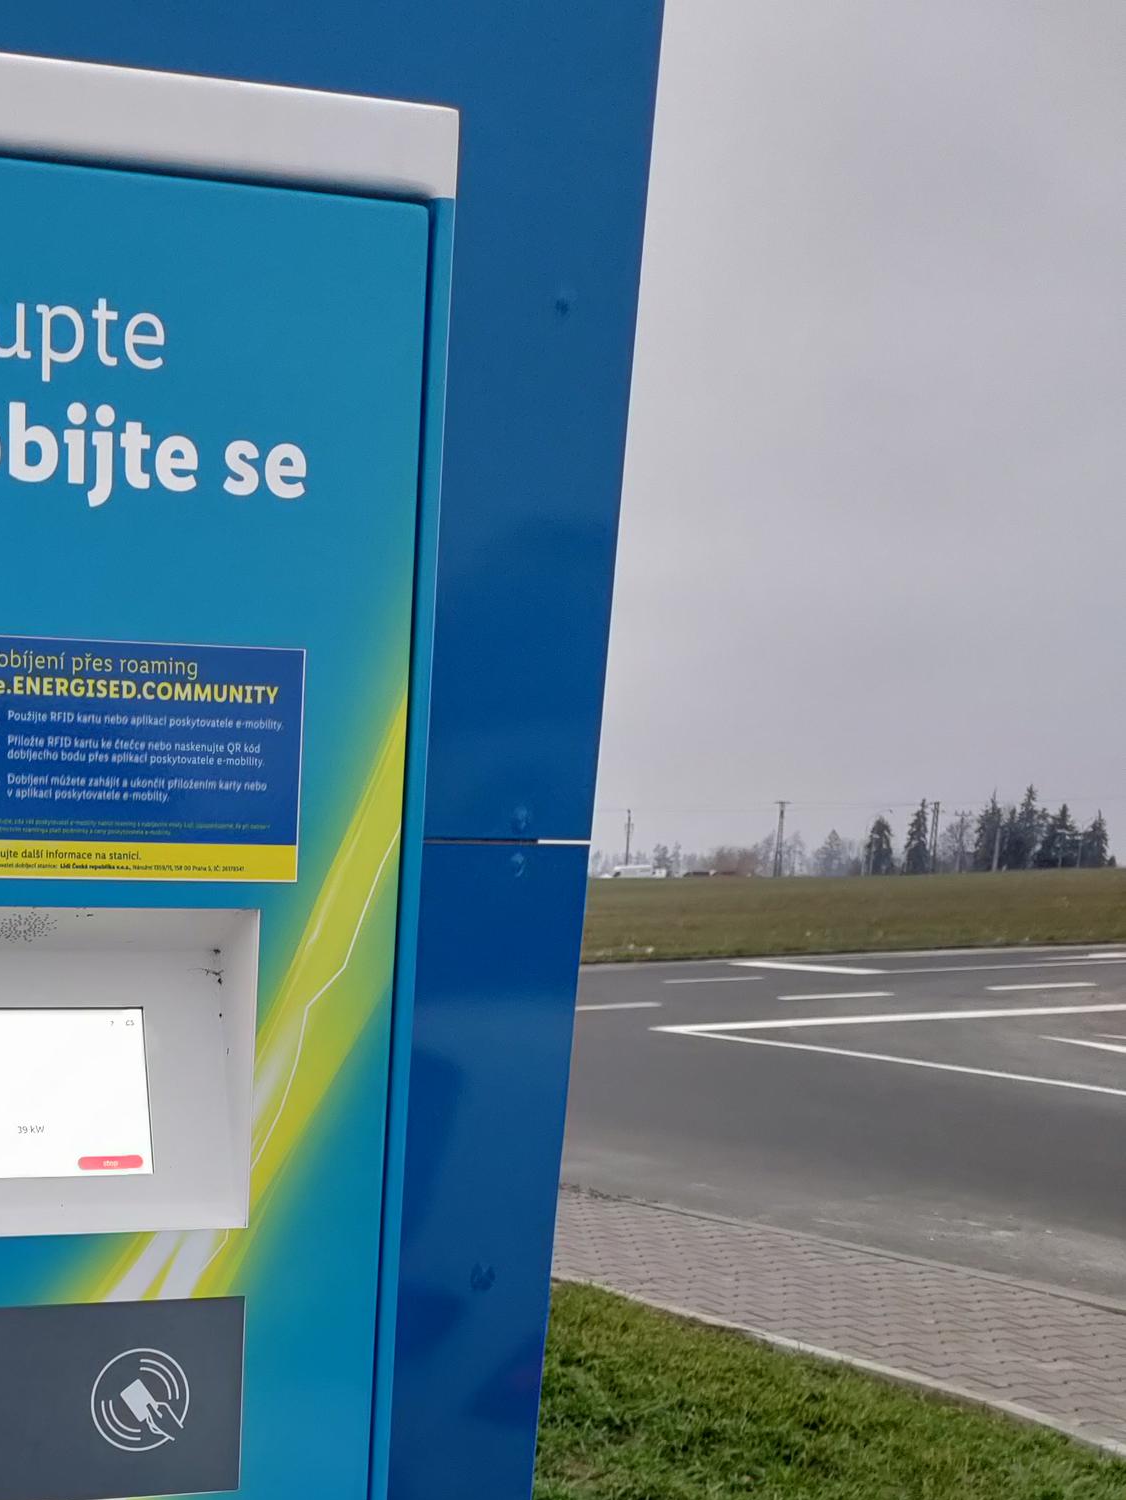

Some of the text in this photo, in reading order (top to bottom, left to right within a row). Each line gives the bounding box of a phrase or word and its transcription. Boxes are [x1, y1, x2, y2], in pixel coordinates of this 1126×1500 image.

[223, 438, 308, 500] se
[71, 651, 113, 675] přes
[120, 658, 199, 681] roaming
[7, 710, 47, 723] Použijte
[50, 711, 75, 722] RFID
[77, 713, 102, 724] kartu
[104, 714, 128, 725] nebo
[130, 715, 167, 727] aplikaci
[169, 716, 233, 729] poskytovatele
[7, 734, 44, 747] Přiložte
[47, 736, 71, 748] RFID
[74, 737, 99, 749] kartu
[101, 739, 112, 749] ke
[148, 740, 172, 751] nebo
[174, 742, 225, 754] naskenujte
[227, 743, 242, 755] QR
[244, 743, 260, 754] kód
[61, 750, 86, 761] bodu
[88, 751, 109, 763] přes
[111, 751, 148, 765] aplikaci
[150, 753, 214, 766] poskytovatele
[51, 775, 86, 786] můžete
[88, 775, 120, 789] zahájit
[122, 778, 128, 787] a
[131, 777, 165, 789] ukončit
[167, 778, 217, 791] přiložením
[218, 780, 242, 793] karty
[244, 780, 267, 791] nebo
[7, 789, 13, 797] v
[15, 787, 52, 801] aplikaci
[55, 788, 120, 802] poskytovatele
[21, 849, 43, 859] další
[46, 850, 93, 860] informace
[95, 852, 106, 860] na
[17, 1125, 45, 1134] 39 kW
